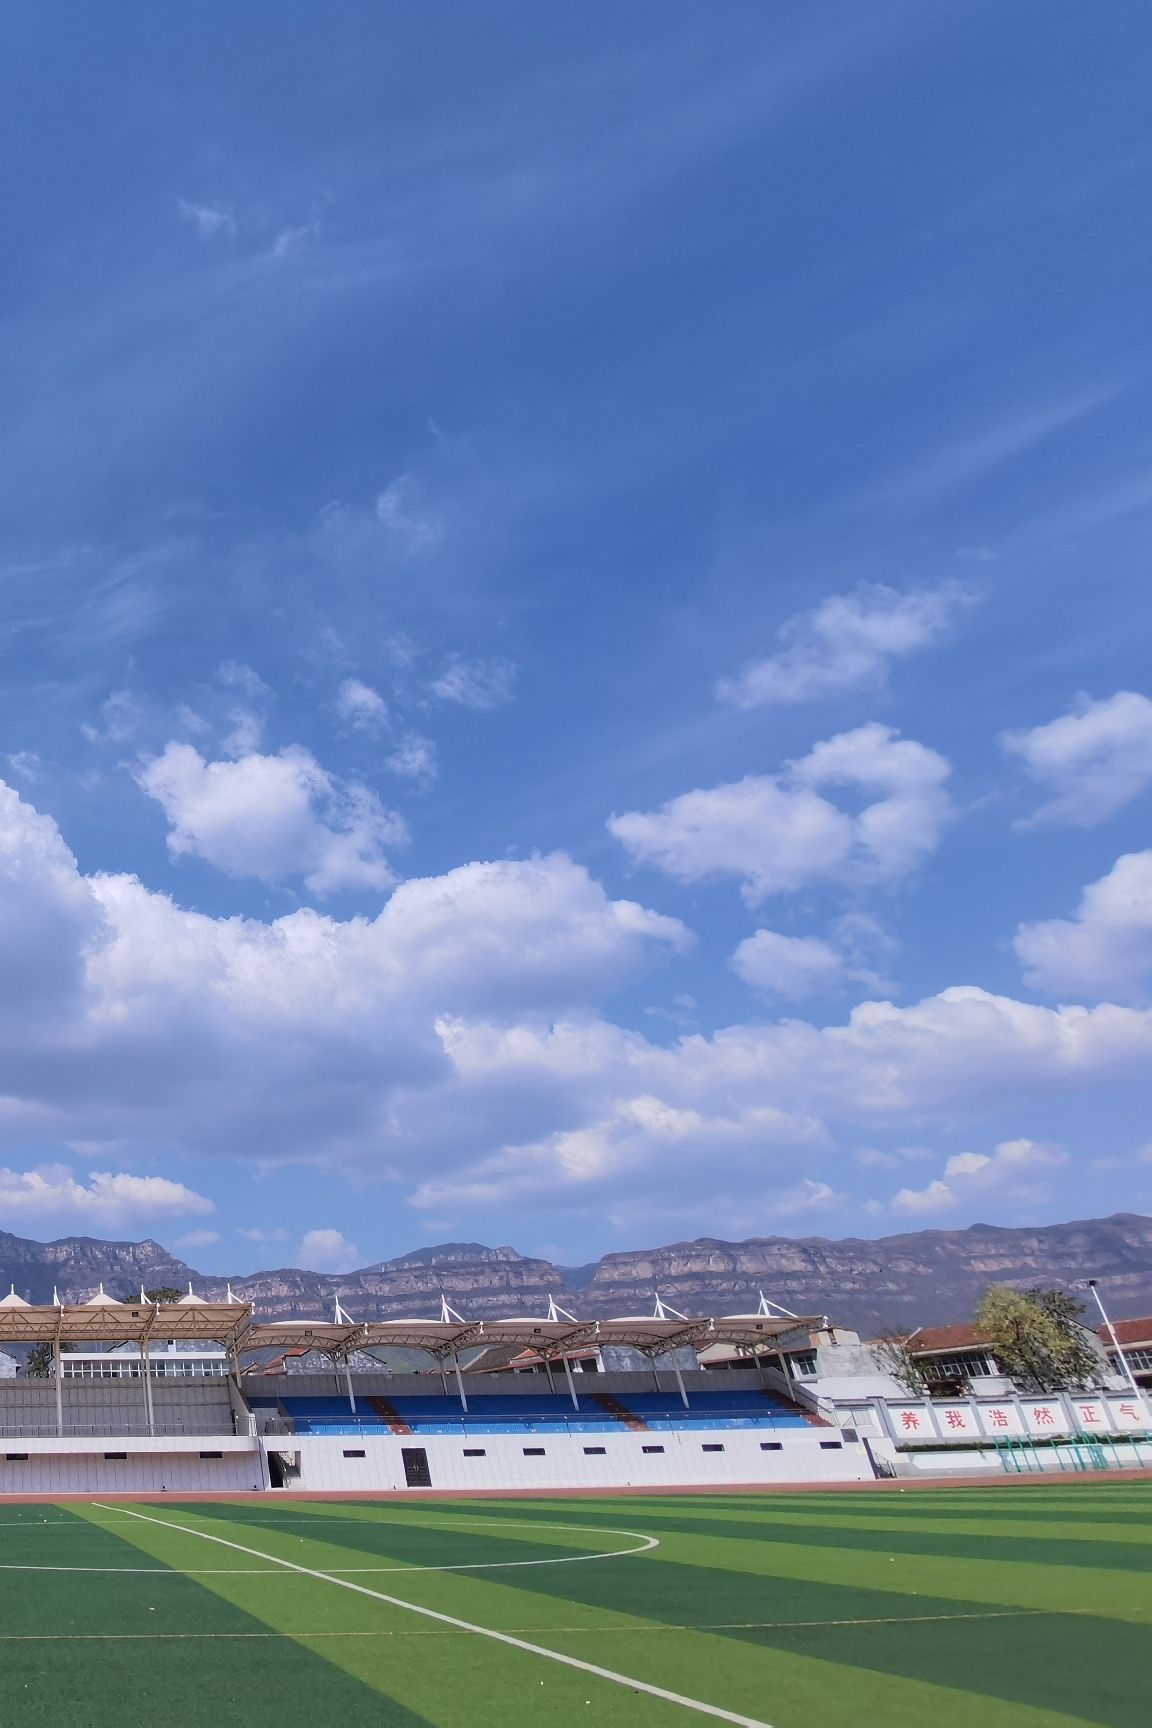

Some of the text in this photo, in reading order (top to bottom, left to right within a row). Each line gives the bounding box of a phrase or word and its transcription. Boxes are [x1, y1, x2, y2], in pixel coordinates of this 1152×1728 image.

[900, 1403, 1140, 1430] 养我浩然正气
